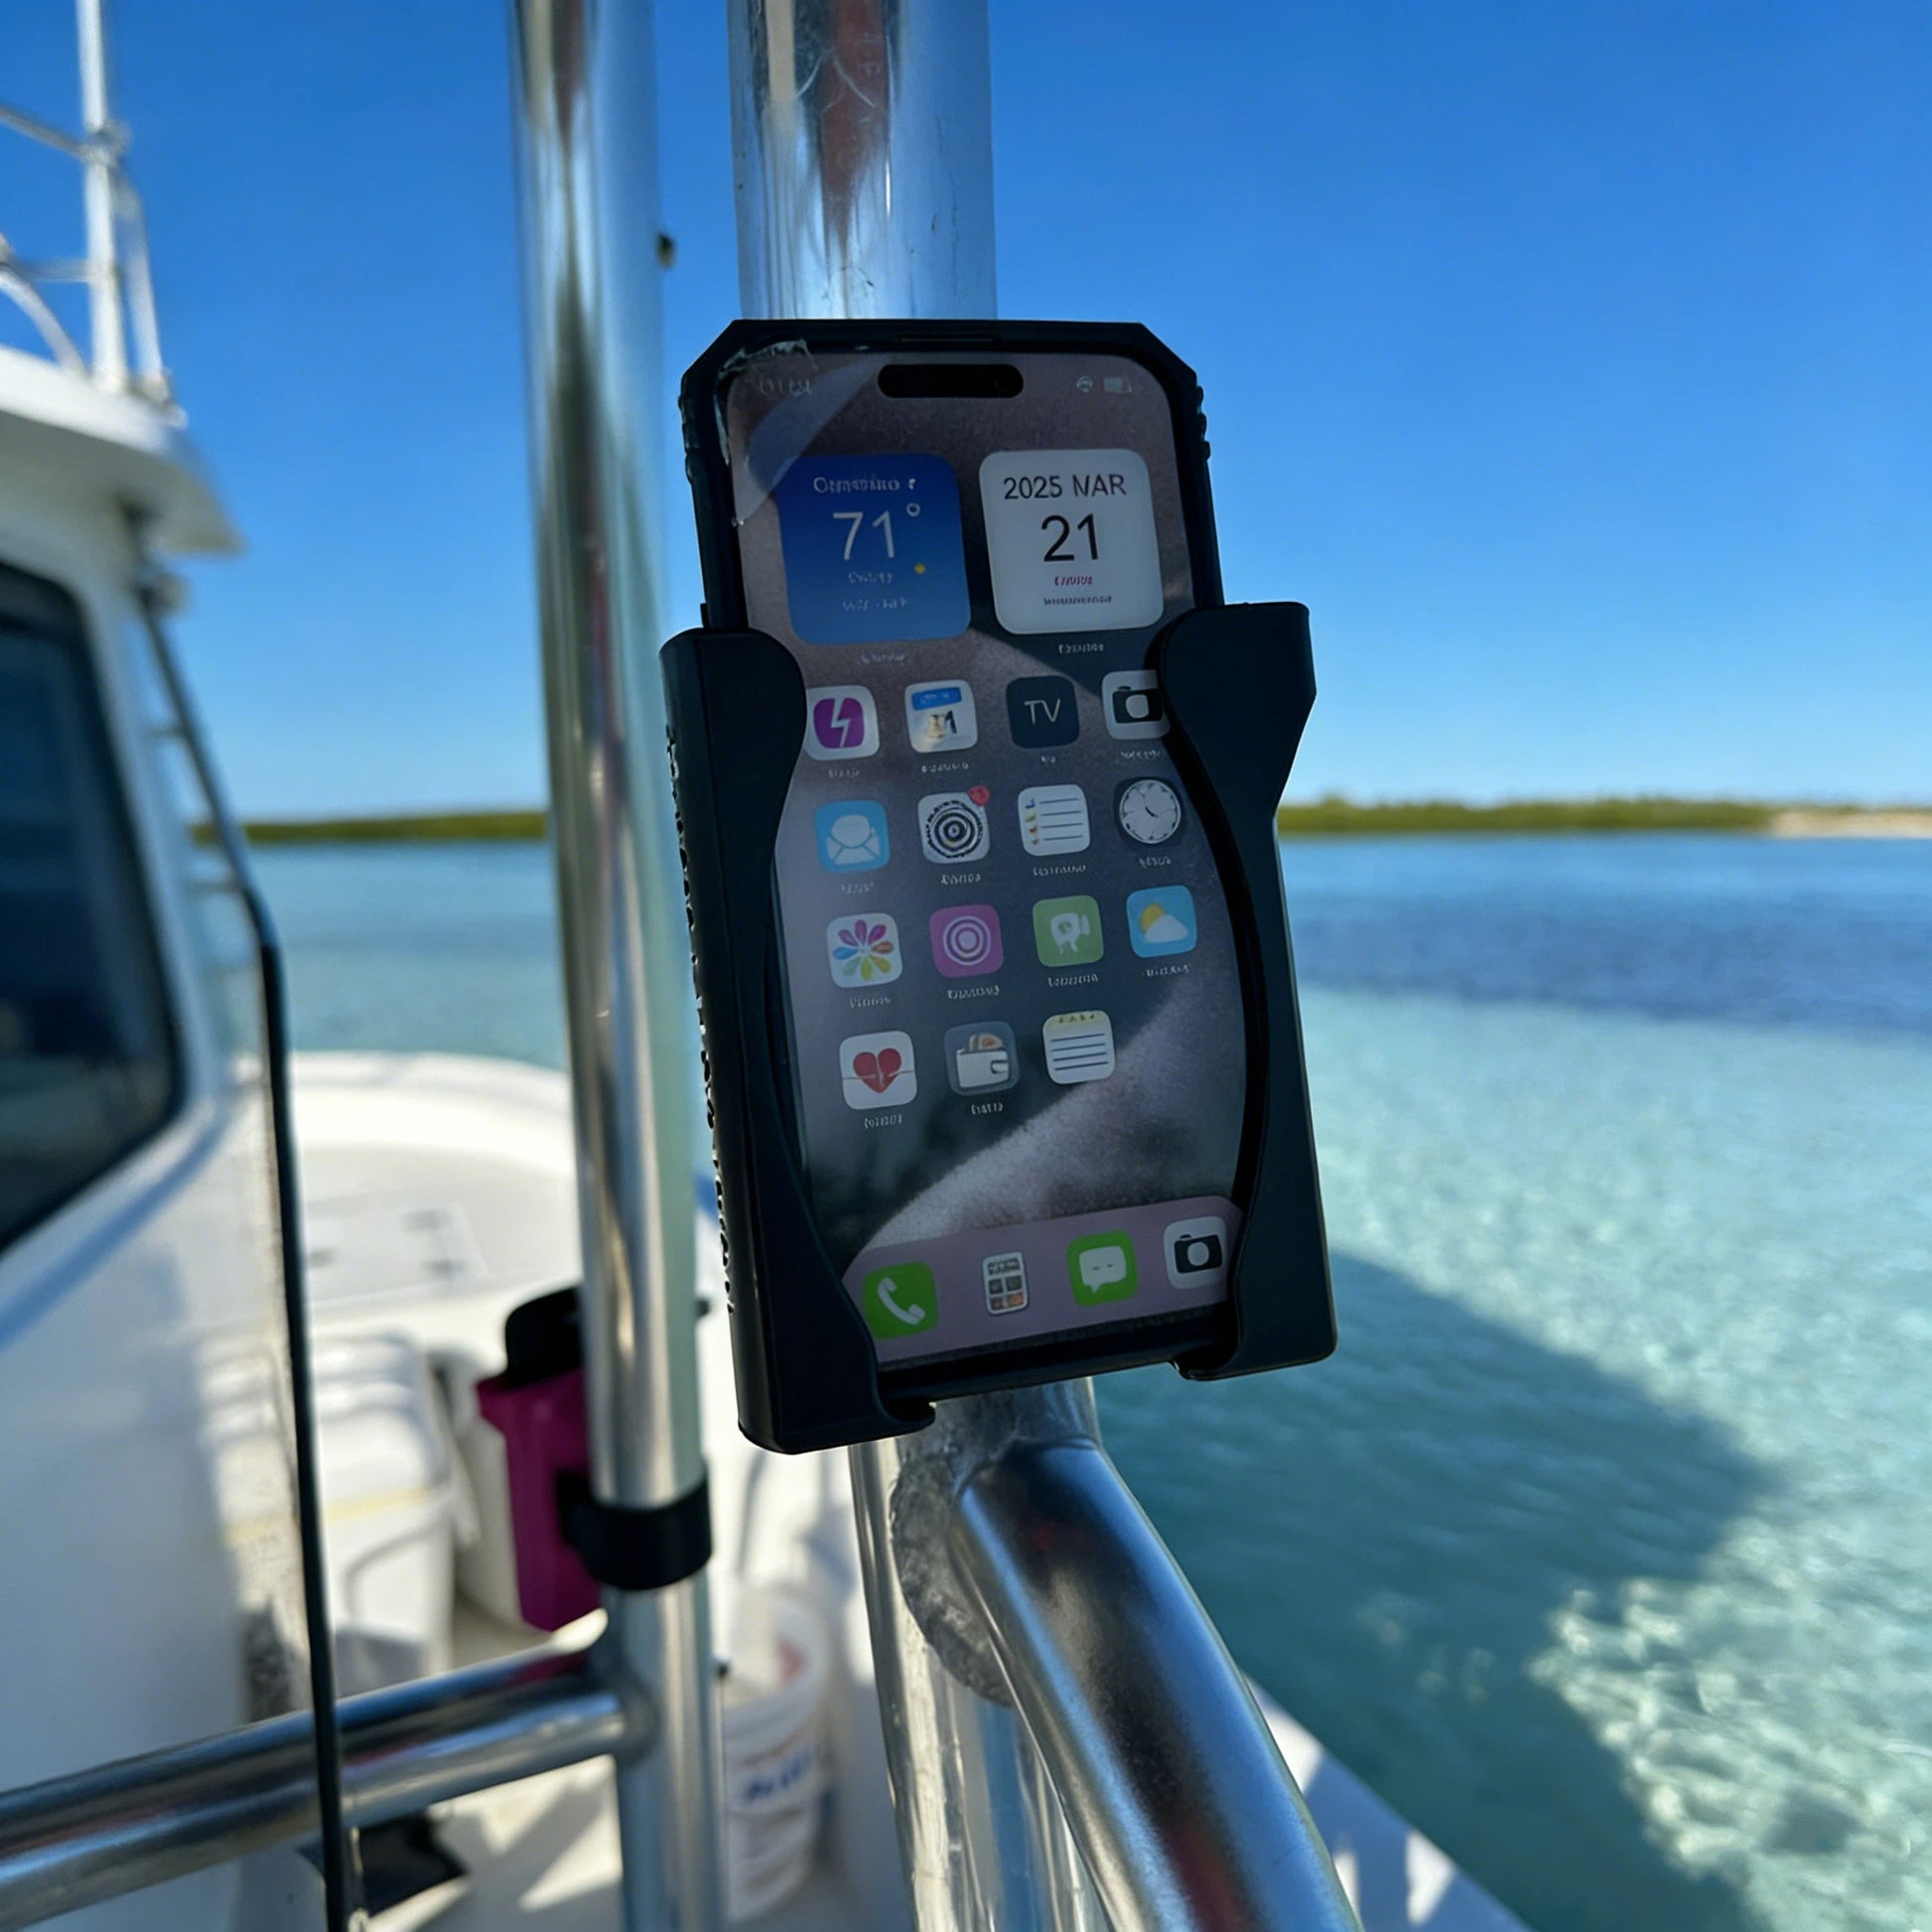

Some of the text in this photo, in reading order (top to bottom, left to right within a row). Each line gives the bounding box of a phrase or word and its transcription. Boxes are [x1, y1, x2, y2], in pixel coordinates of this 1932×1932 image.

[1003, 476, 1062, 499] 2025
[1040, 513, 1098, 562] 21
[1024, 698, 1061, 725] TV
